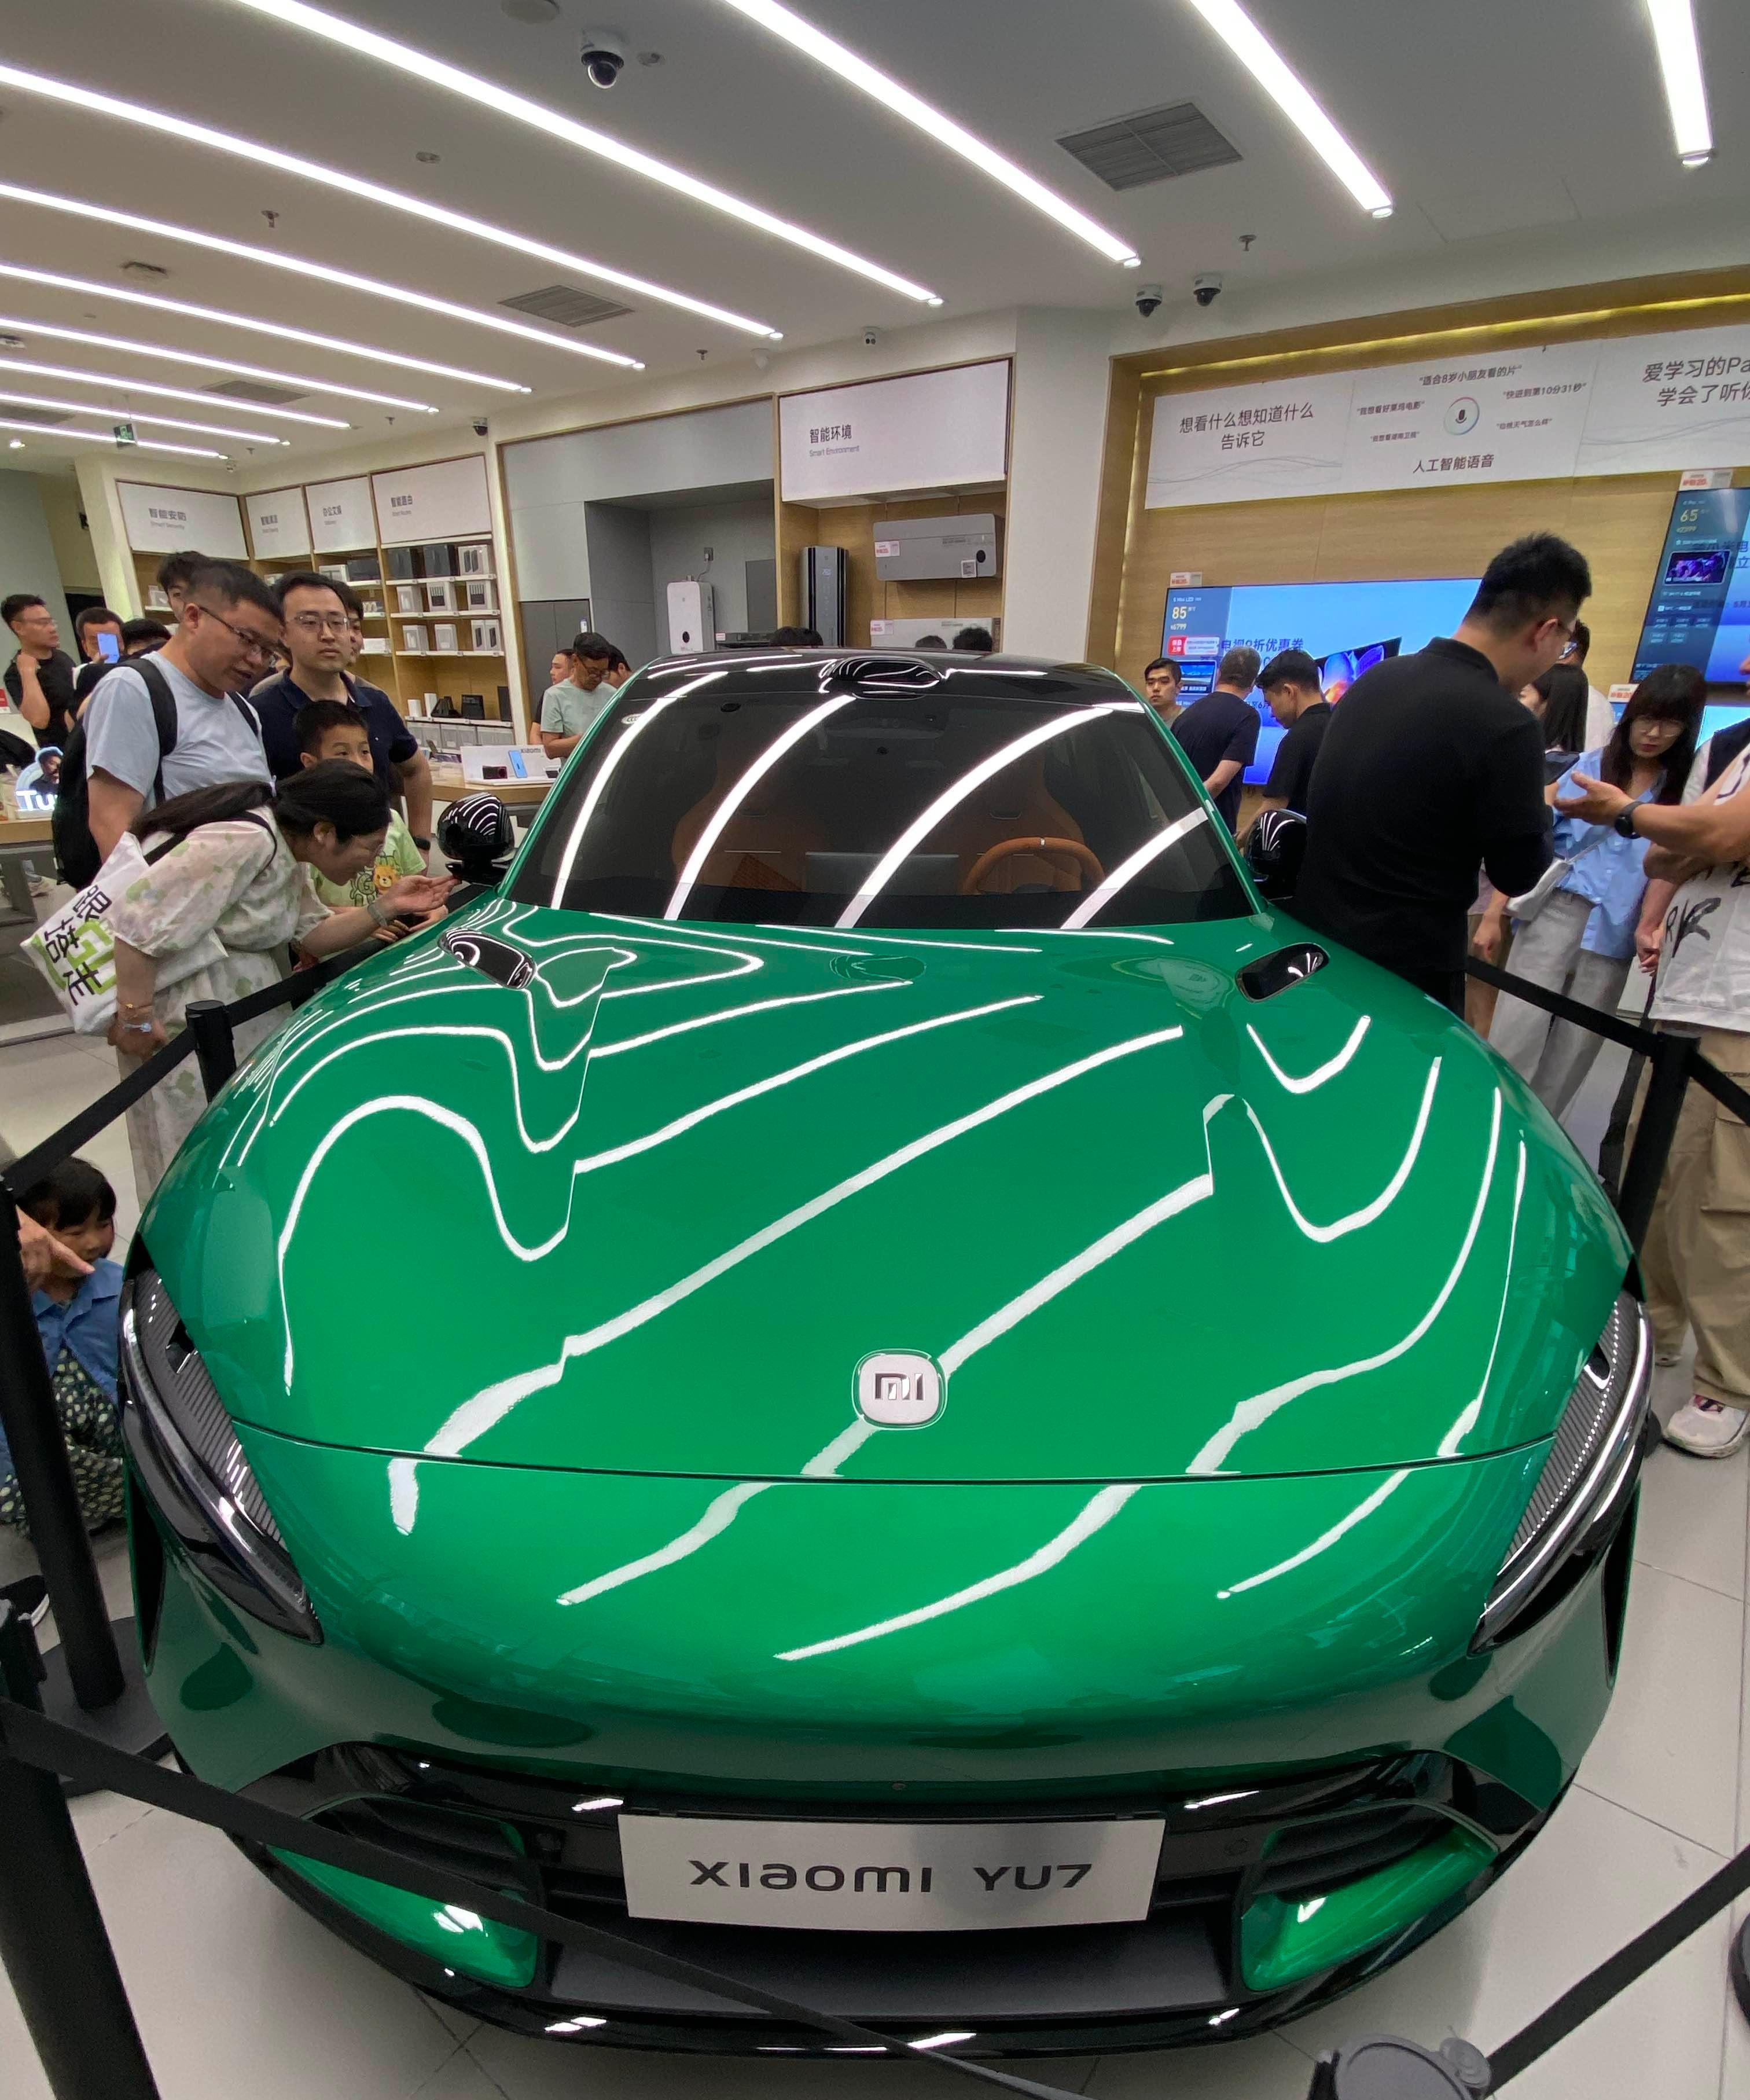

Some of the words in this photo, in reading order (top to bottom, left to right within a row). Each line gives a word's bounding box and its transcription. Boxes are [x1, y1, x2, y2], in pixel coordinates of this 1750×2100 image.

[1179, 402, 1314, 434] 想看什么想知道什么
[810, 424, 852, 444] 智能环境
[1221, 430, 1266, 451] 告诉它
[809, 449, 825, 457] Smart
[1413, 454, 1495, 474] 人工智能语音
[1680, 509, 1700, 523] 65
[1172, 606, 1188, 620] 85
[973, 1864, 1092, 1891] YU7
